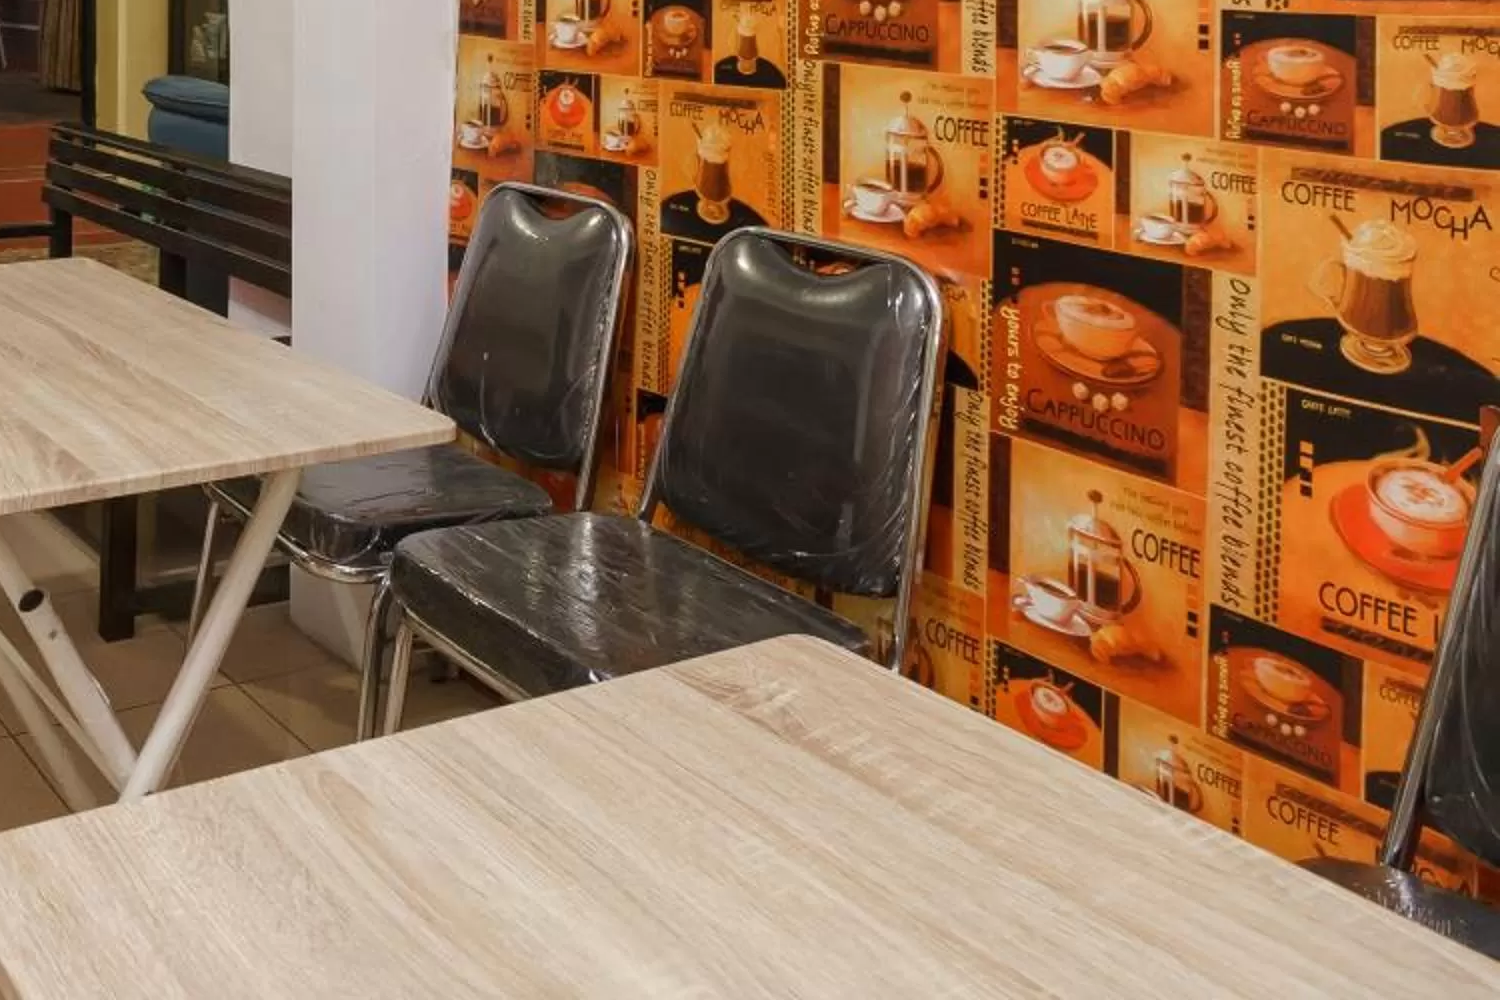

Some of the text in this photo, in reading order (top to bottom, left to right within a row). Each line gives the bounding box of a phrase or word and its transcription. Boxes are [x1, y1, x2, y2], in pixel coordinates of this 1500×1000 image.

[804, 14, 826, 55] enjoy
[825, 13, 930, 43] CAPPUCCINO
[1392, 36, 1500, 56] COFFEE MOC
[972, 30, 995, 74] blends
[670, 103, 765, 135] COFFEE MOCHA
[934, 115, 989, 148] COFFEE
[1247, 109, 1348, 136] CAPPUCCINO
[1211, 171, 1257, 195] COFFEE
[1021, 201, 1097, 230] COFFEE LATTE
[1281, 181, 1493, 240] COFFEE MOCHA
[998, 305, 1026, 430] yours to enjoy
[1026, 388, 1165, 451] CAPPUCCINO
[1214, 278, 1257, 608] Only the finest coffee blends
[1131, 528, 1200, 579] COFFEE
[1318, 580, 1418, 638] COFFEE
[924, 618, 980, 665] COFFEE
[1197, 763, 1242, 798] COFFEE
[1265, 795, 1340, 846] COFFEE
